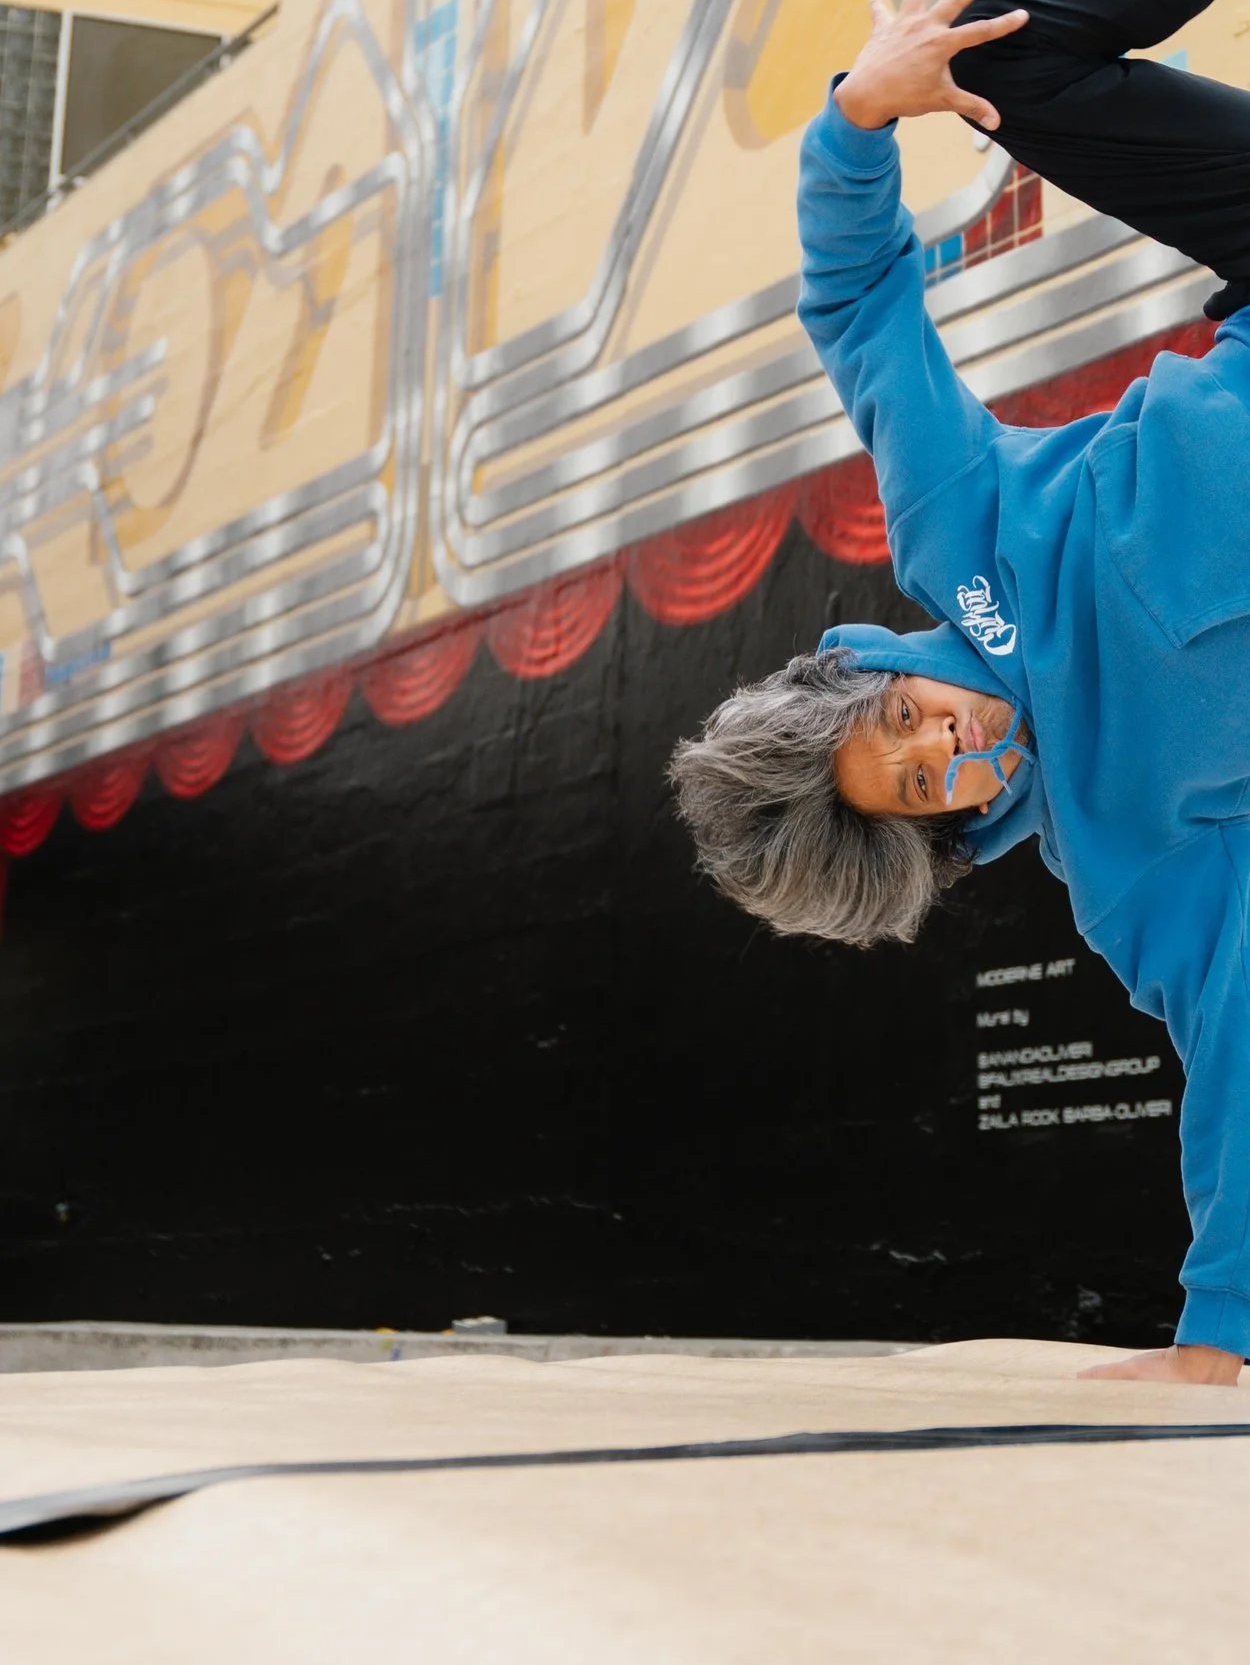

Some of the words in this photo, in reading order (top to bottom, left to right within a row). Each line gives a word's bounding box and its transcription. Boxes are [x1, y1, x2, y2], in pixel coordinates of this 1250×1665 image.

[976, 963, 1043, 987] MODERNE
[1045, 958, 1076, 978] ART
[976, 1008, 1011, 1028] Mural
[1020, 1108, 1060, 1126] ROCK
